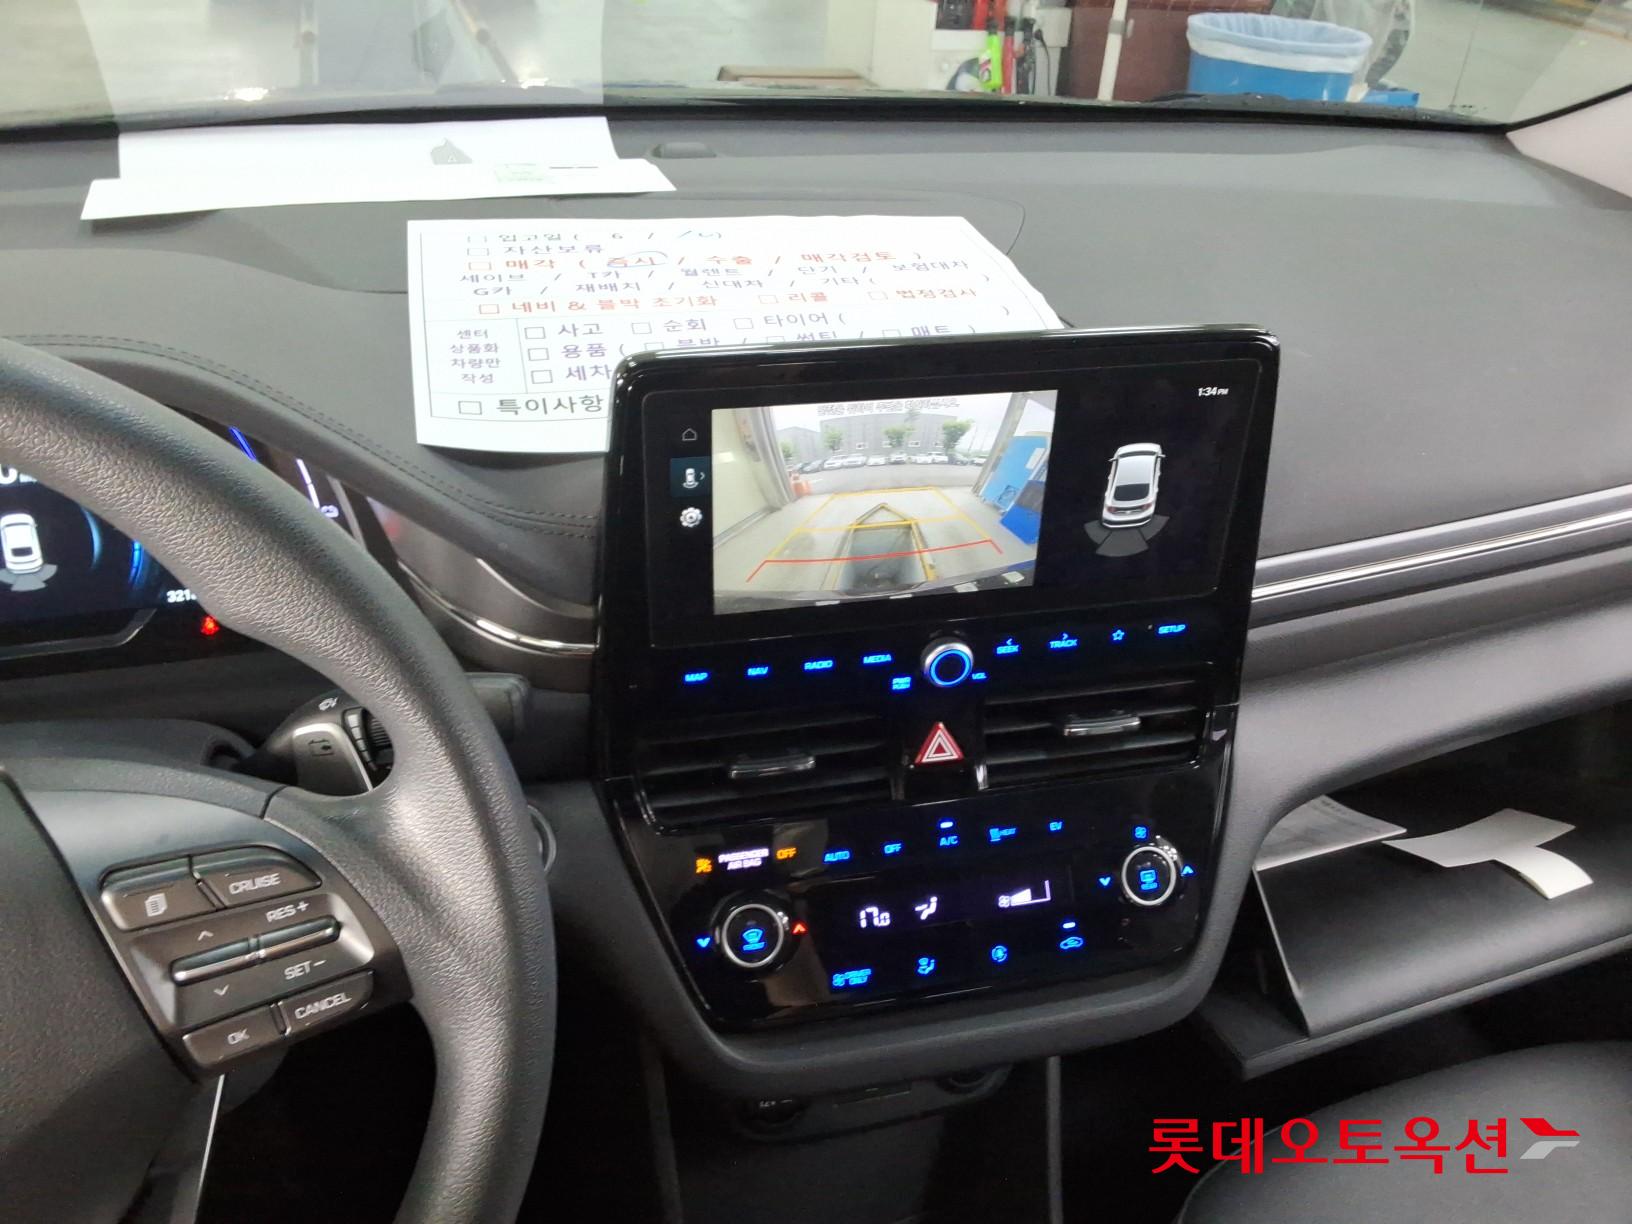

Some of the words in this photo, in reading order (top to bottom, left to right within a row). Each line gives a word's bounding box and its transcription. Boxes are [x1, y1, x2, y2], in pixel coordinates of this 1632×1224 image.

[504, 244, 604, 256] 자산보류
[505, 258, 556, 270] 매각
[705, 254, 753, 266] 수출
[800, 250, 897, 264] 매각검토
[460, 272, 527, 283] 세이브
[797, 265, 838, 275] 단기
[472, 286, 513, 297] G카
[575, 281, 642, 293] 재배치
[822, 276, 860, 287] 기타
[512, 300, 556, 313] 네비
[567, 301, 586, 311] &
[598, 297, 640, 310] 블박
[654, 295, 718, 308] 초기화
[788, 292, 829, 304] 리콜
[558, 323, 604, 338] 사고
[663, 318, 708, 332] 순회
[764, 312, 830, 328] 타이어
[456, 328, 489, 340] 센터
[450, 342, 500, 354] 상품화
[561, 344, 608, 359] 용품
[450, 356, 501, 368] 차량만
[565, 364, 612, 380] 세차
[460, 373, 496, 384] 작성
[495, 395, 604, 415] 특이사항
[1158, 624, 1187, 634] SETUP
[996, 643, 1020, 655] SEEK
[1049, 638, 1078, 649] TRACK
[803, 659, 834, 670] RADIO
[862, 654, 893, 664] MEDIA
[684, 672, 709, 682] MAP
[747, 666, 769, 676] NAV
[939, 836, 958, 847] A/C
[776, 847, 796, 860] OFF
[884, 843, 903, 854] OFF
[823, 850, 851, 862] AUTO
[229, 873, 281, 895] CRUISE
[266, 901, 310, 922] RES+
[294, 992, 352, 1020] CANCEL
[228, 1029, 250, 1045] OK
